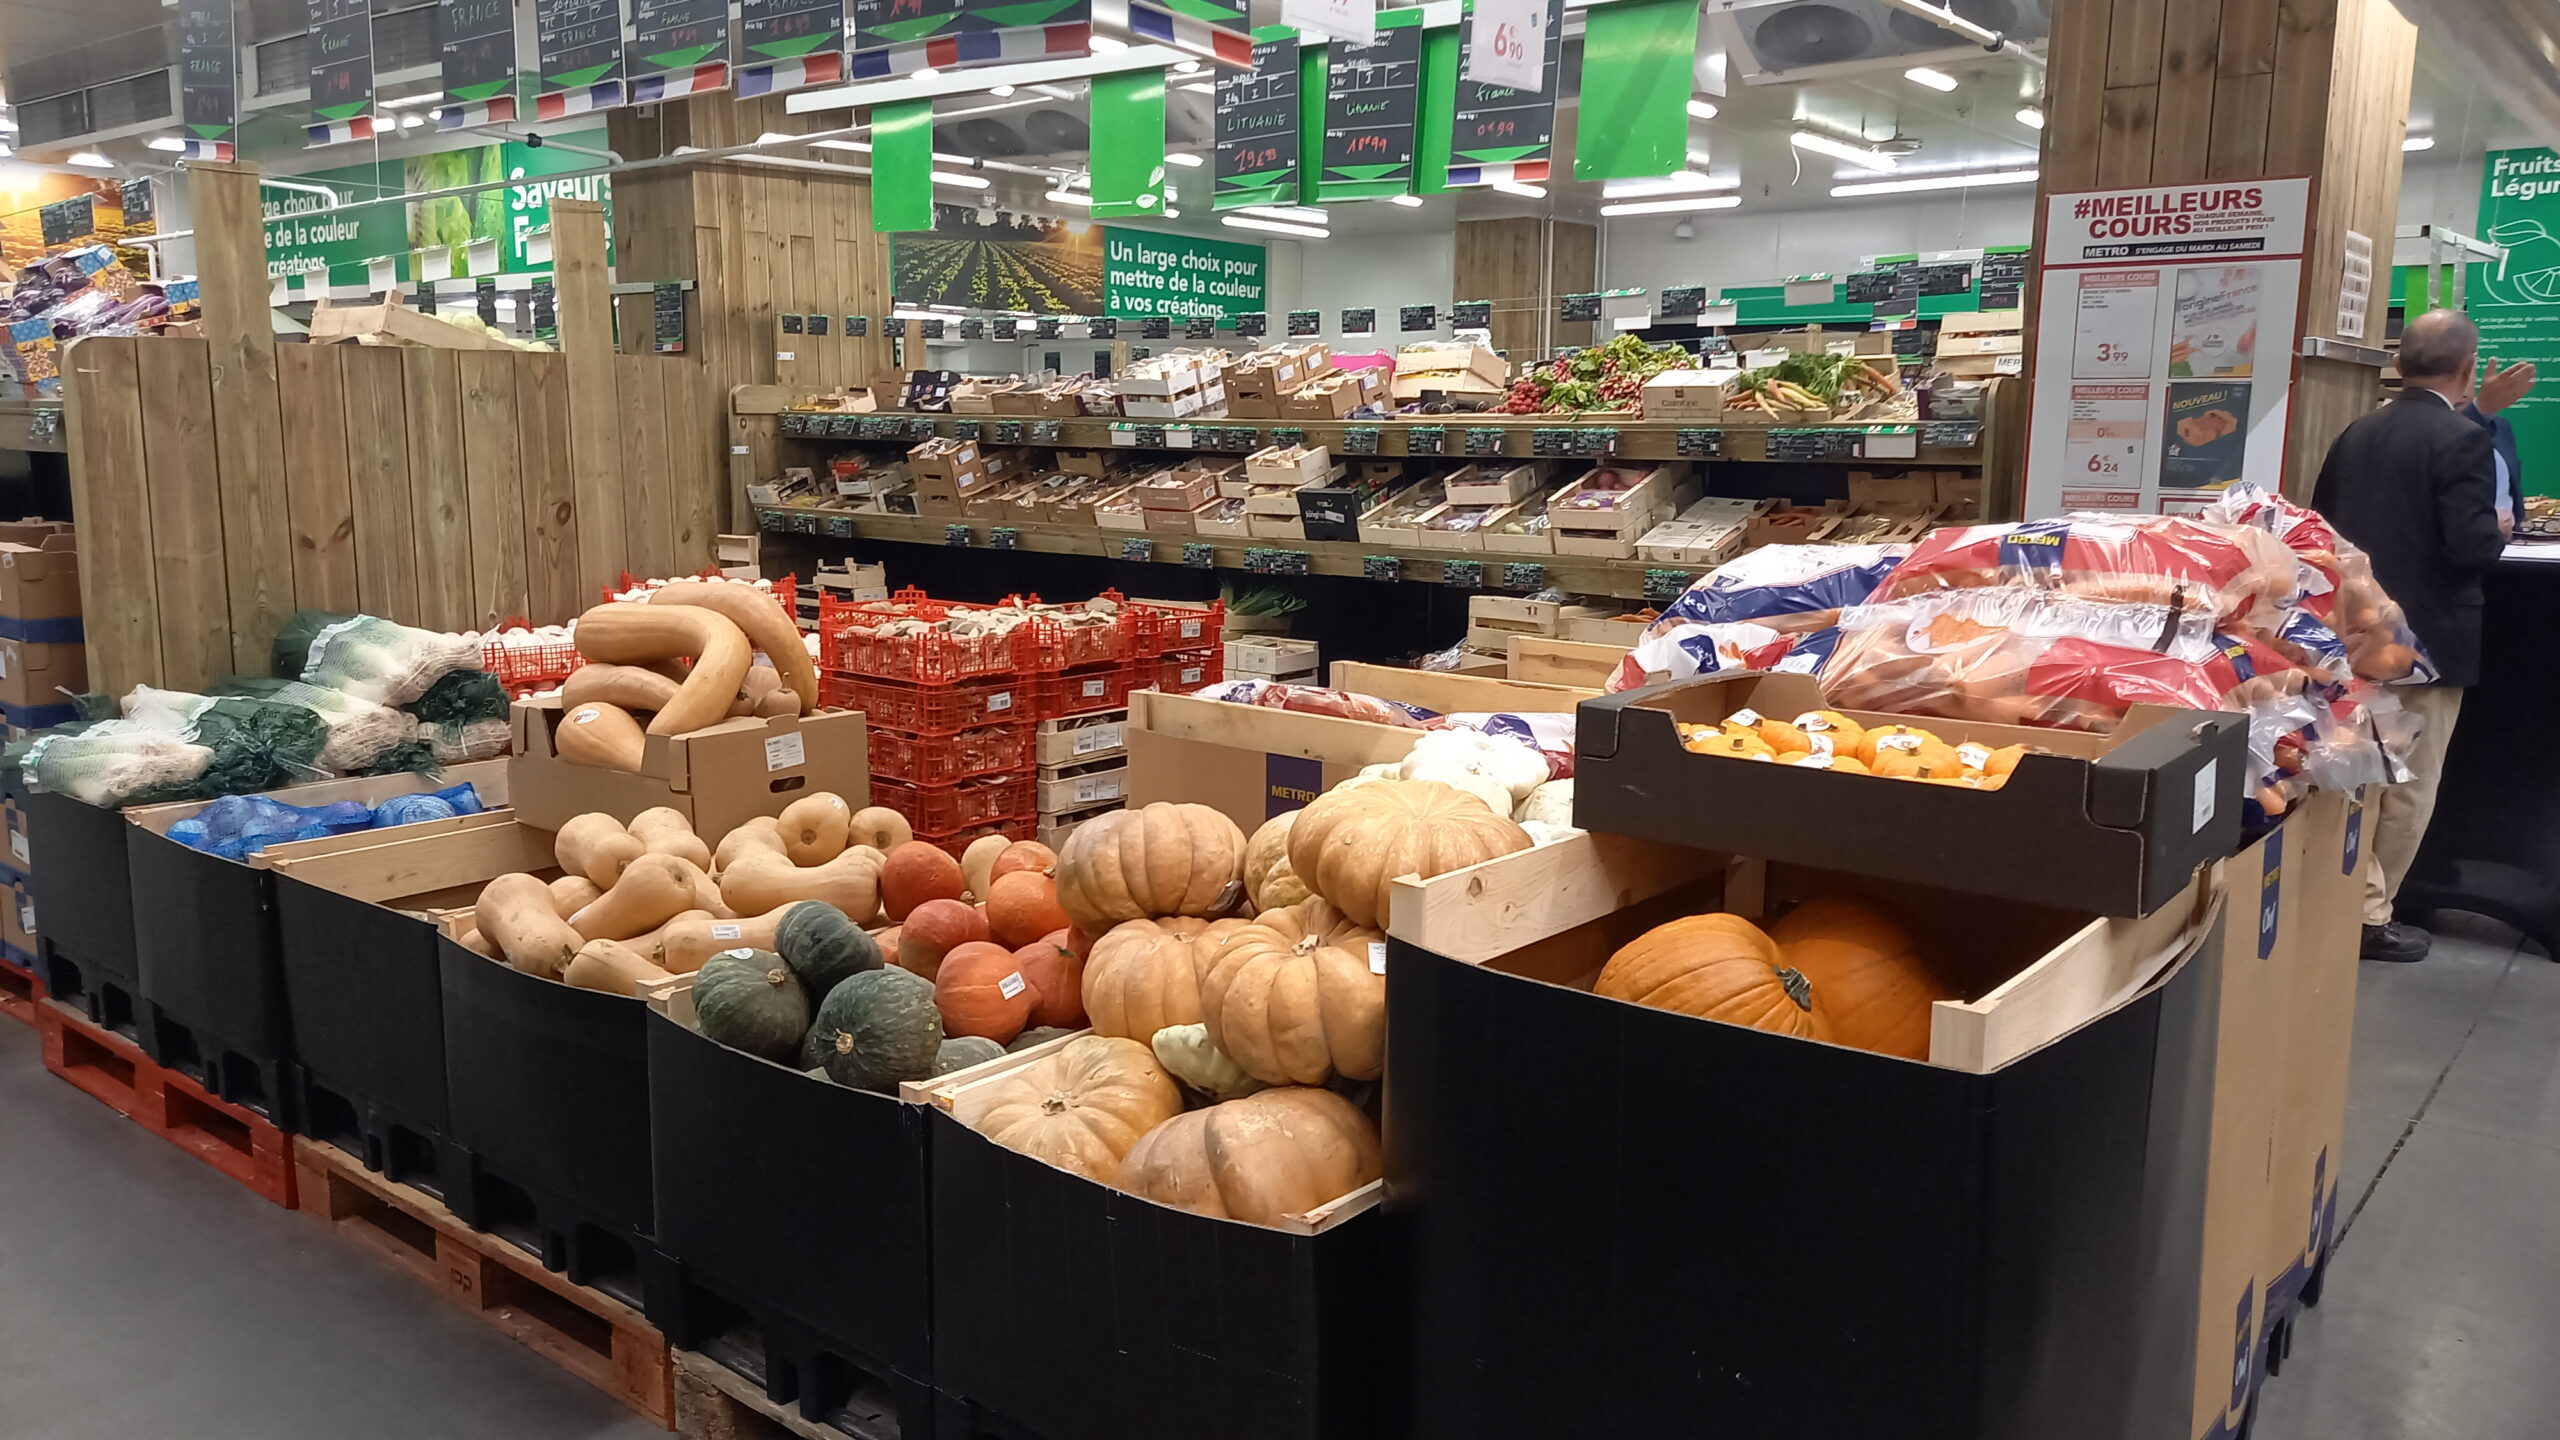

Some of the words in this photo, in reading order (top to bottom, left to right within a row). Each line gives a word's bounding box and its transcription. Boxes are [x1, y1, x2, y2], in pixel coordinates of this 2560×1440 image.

[1227, 109, 1287, 132] LITUANIE
[284, 189, 318, 214] choix
[2074, 188, 2264, 219] #MEILLEURS
[275, 221, 293, 247] de
[295, 219, 308, 246] la
[310, 215, 360, 244] couleur
[2089, 214, 2192, 239] COURS
[1110, 240, 1133, 263] Un
[1137, 243, 1177, 272] large
[1181, 249, 1221, 273] choix
[1224, 259, 1258, 279] pour
[2085, 246, 2129, 258] METRO
[2135, 245, 2174, 255] S'ENGAGE
[2175, 244, 2188, 253] DU
[2188, 242, 2216, 252] MARDI
[2216, 242, 2229, 251] AU
[2229, 240, 2262, 250] SAMEDI
[1110, 269, 1165, 290] mettre
[1168, 271, 1189, 292] de
[1192, 273, 1206, 294] la
[1209, 277, 1262, 300] couleur
[1110, 289, 1121, 310] à
[1124, 296, 1153, 312] vos
[1156, 295, 1229, 319] créations.
[2172, 391, 2223, 411] NOUVEAU
[1271, 785, 1316, 803] METRO
